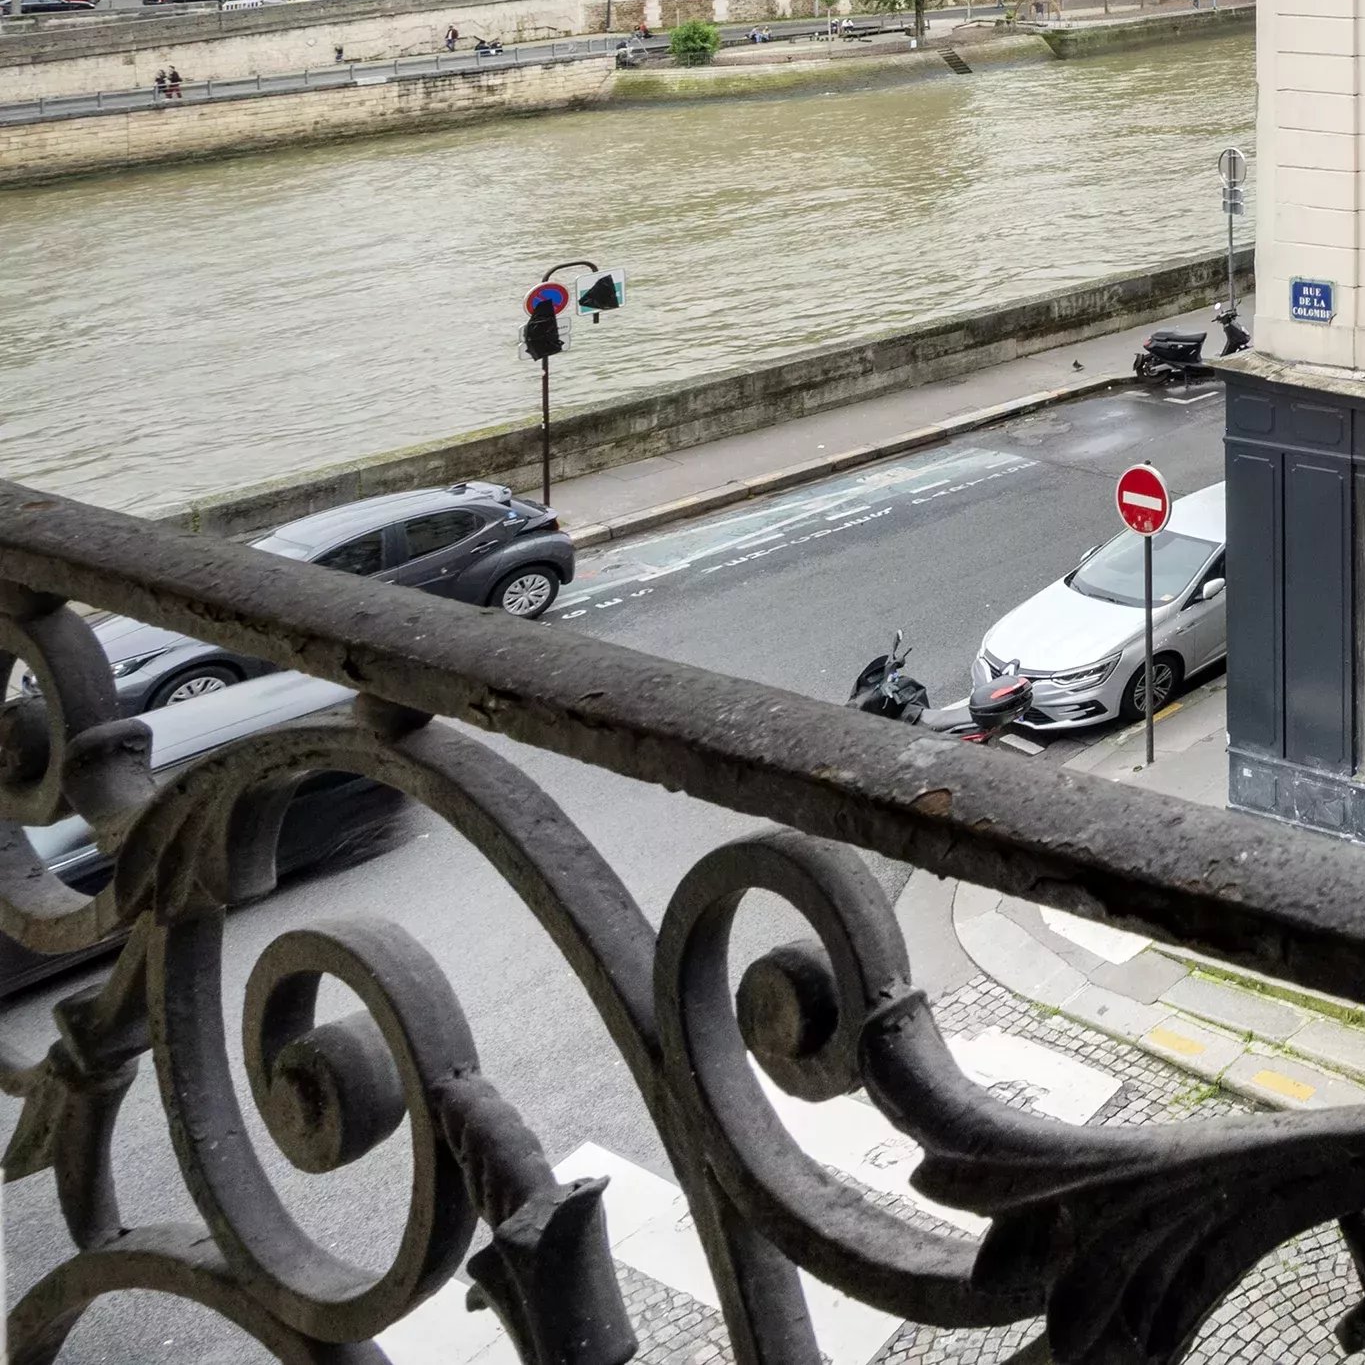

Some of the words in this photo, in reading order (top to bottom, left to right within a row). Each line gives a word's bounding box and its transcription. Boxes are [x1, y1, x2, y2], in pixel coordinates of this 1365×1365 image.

[1302, 286, 1322, 297] RUE
[1299, 296, 1312, 306] DE
[1313, 298, 1326, 308] LA
[1292, 306, 1332, 319] COLOMBE
